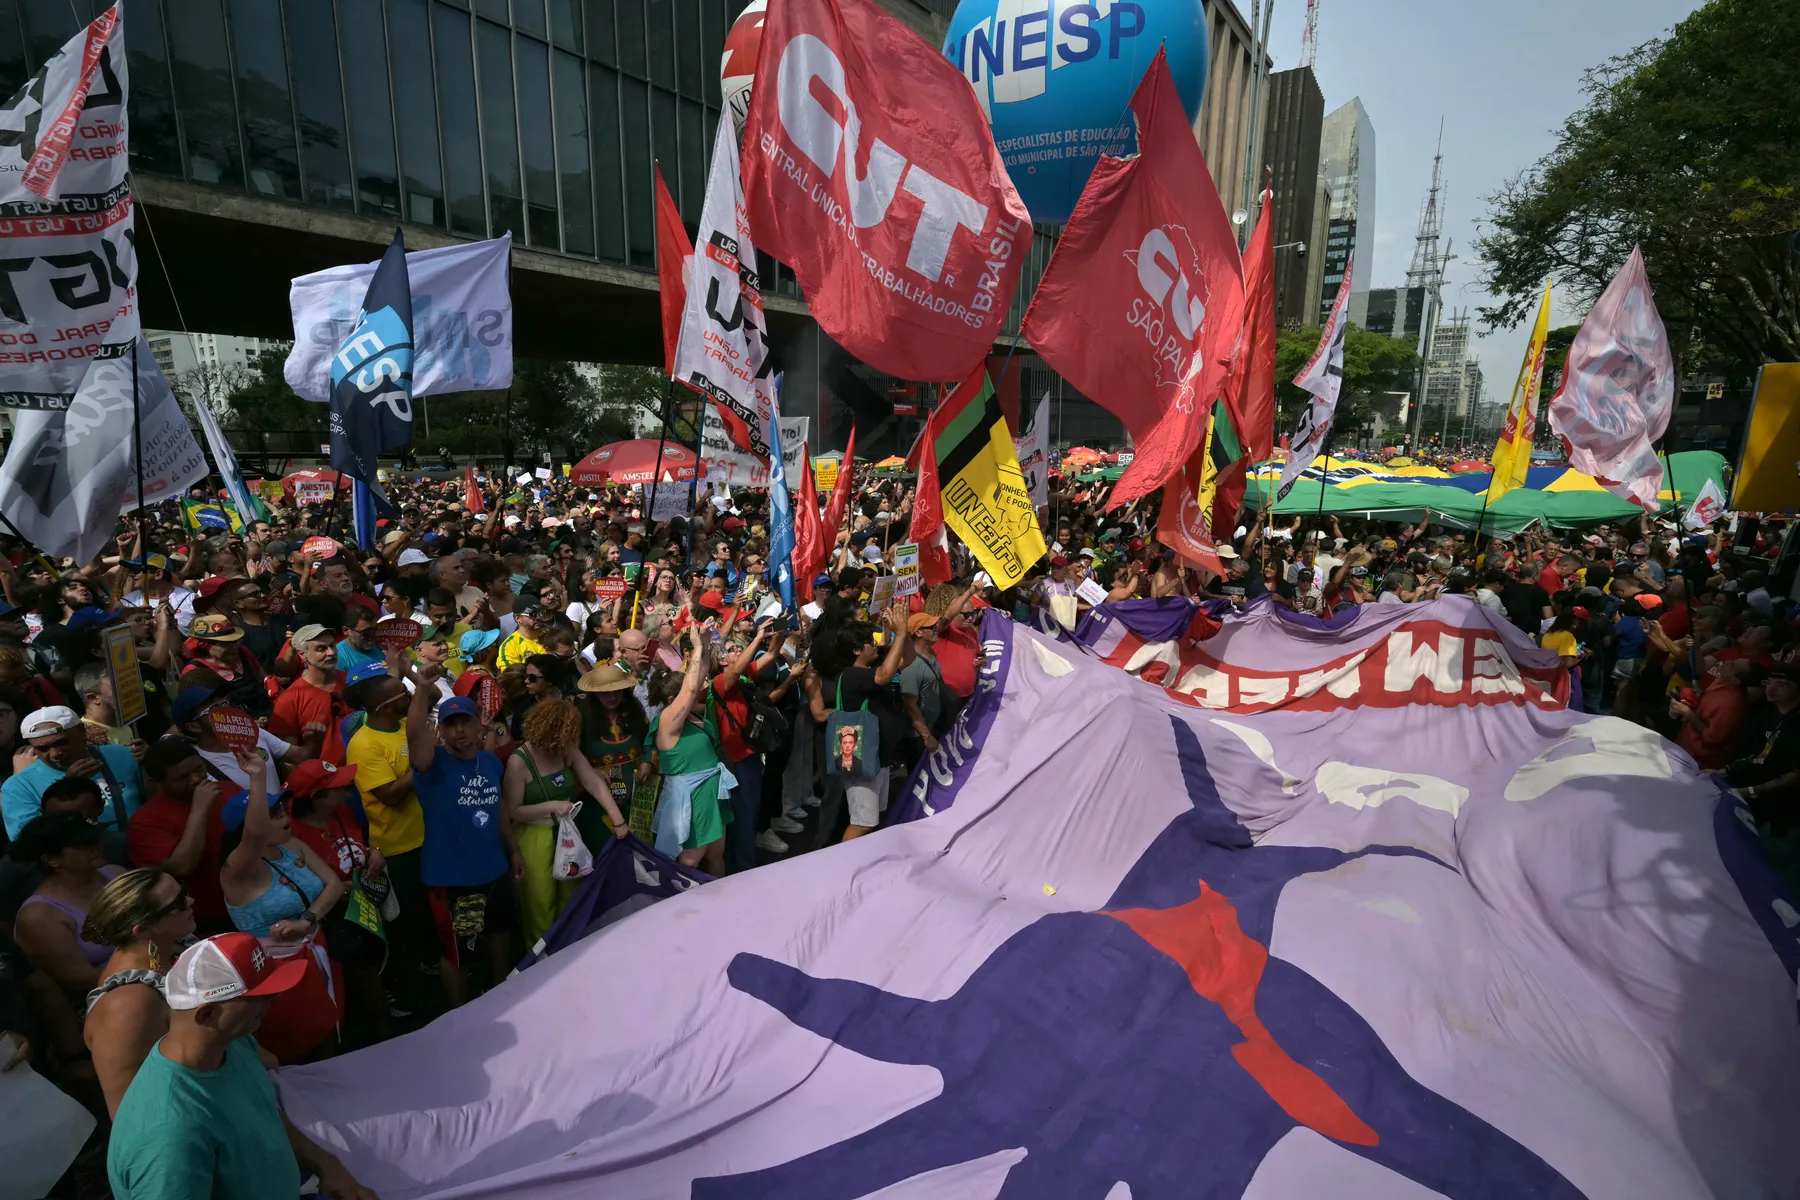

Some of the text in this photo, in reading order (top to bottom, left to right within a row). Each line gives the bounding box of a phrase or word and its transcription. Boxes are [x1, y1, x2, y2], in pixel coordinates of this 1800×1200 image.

[996, 125, 1131, 153] ESPECIALISTAS DE EDUCAÇÃO
[1018, 151, 1063, 165] MUNICIPAL
[1065, 146, 1078, 158] DE
[1079, 143, 1097, 157] SÃO
[760, 126, 809, 194] ENTRAL
[860, 249, 985, 329] TRABALHADORES
[971, 217, 1022, 314] BRASIL
[1126, 298, 1164, 347] SÃO
[579, 472, 601, 483] AMSTEL
[622, 471, 655, 482] AMSTEL
[300, 483, 331, 492] ANISTIA
[1190, 525, 1213, 542] BRAS
[898, 566, 916, 577] SEM
[896, 578, 918, 594] ANISTIA
[374, 629, 418, 638] BANDIDAGEM!
[212, 711, 253, 728] NÃO À PEC DA
[210, 982, 236, 996] JETFILM
